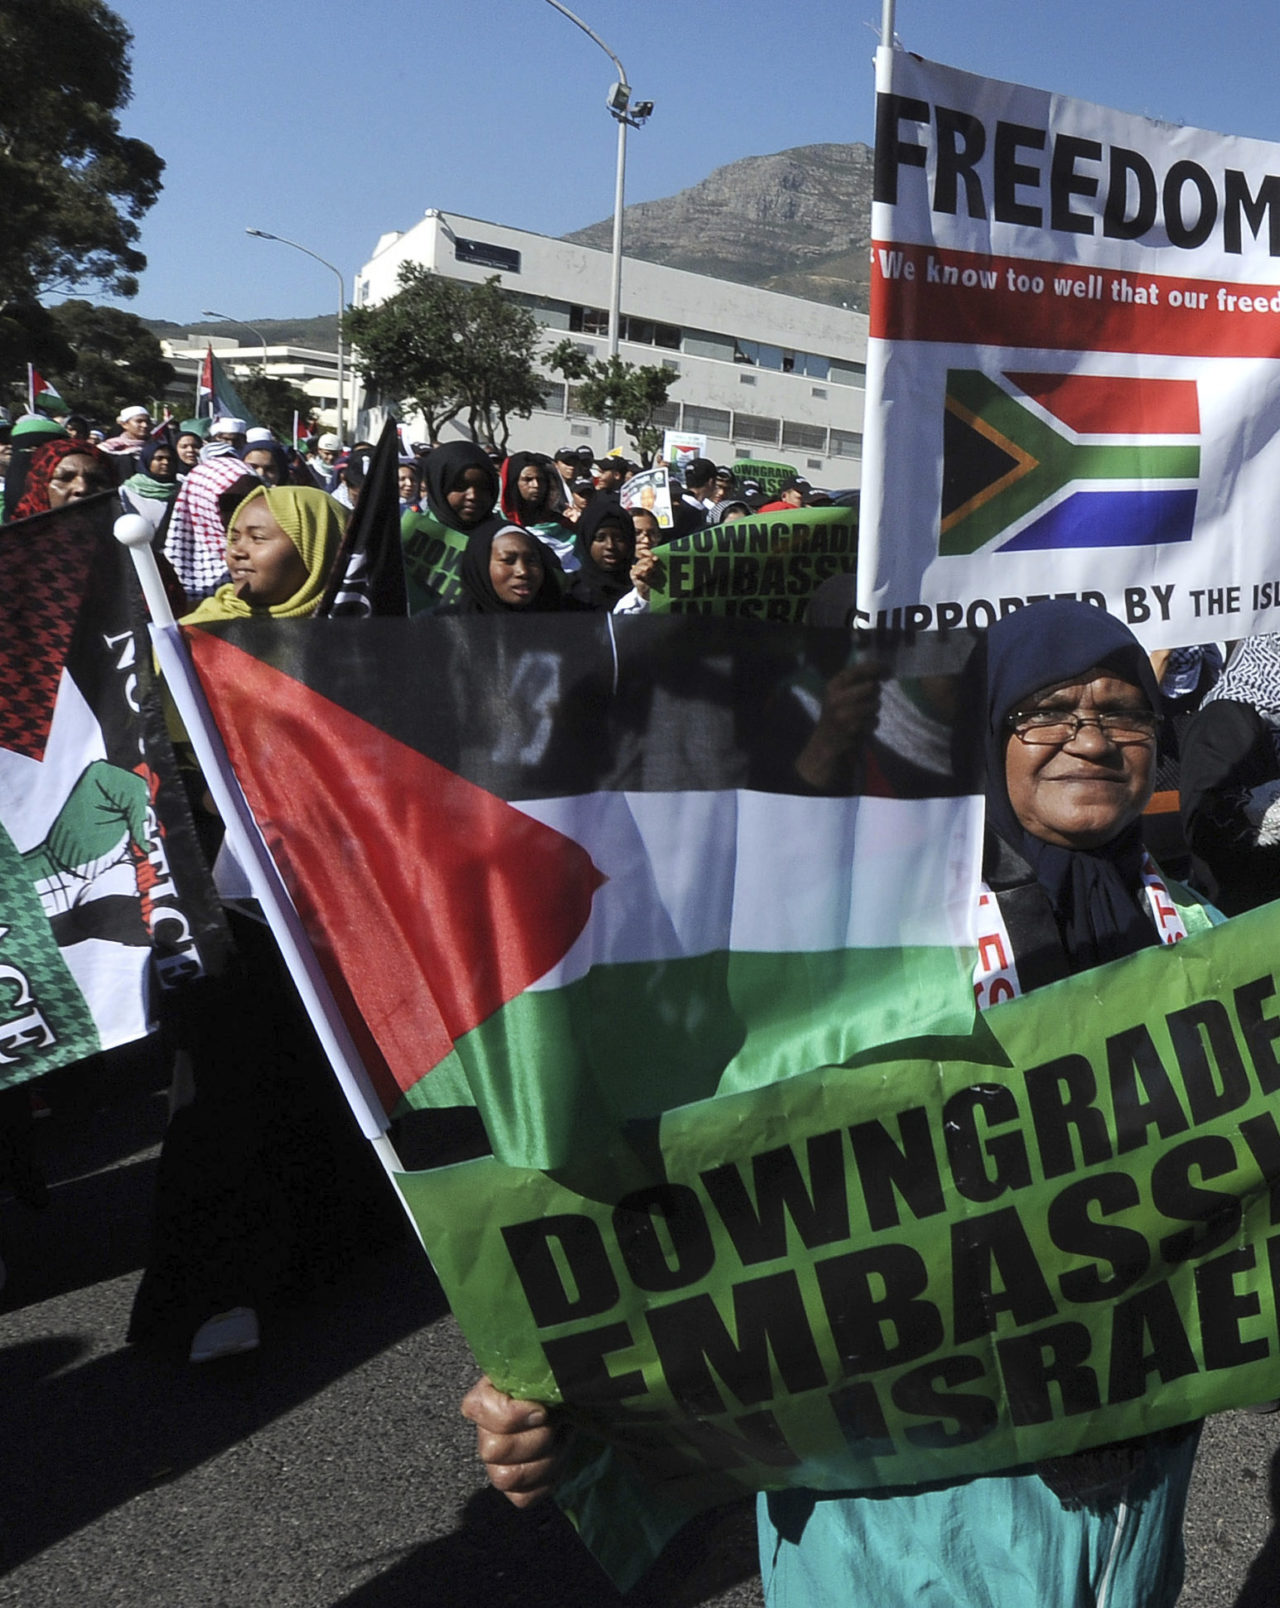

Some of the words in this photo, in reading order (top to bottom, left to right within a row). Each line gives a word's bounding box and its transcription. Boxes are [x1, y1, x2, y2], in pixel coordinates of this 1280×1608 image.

[926, 255, 998, 290] know
[1006, 268, 1045, 294] too
[1053, 274, 1103, 300] well
[1111, 278, 1159, 305] that
[1168, 289, 1208, 310] our
[1124, 584, 1175, 625] BY
[1189, 586, 1241, 617] THE
